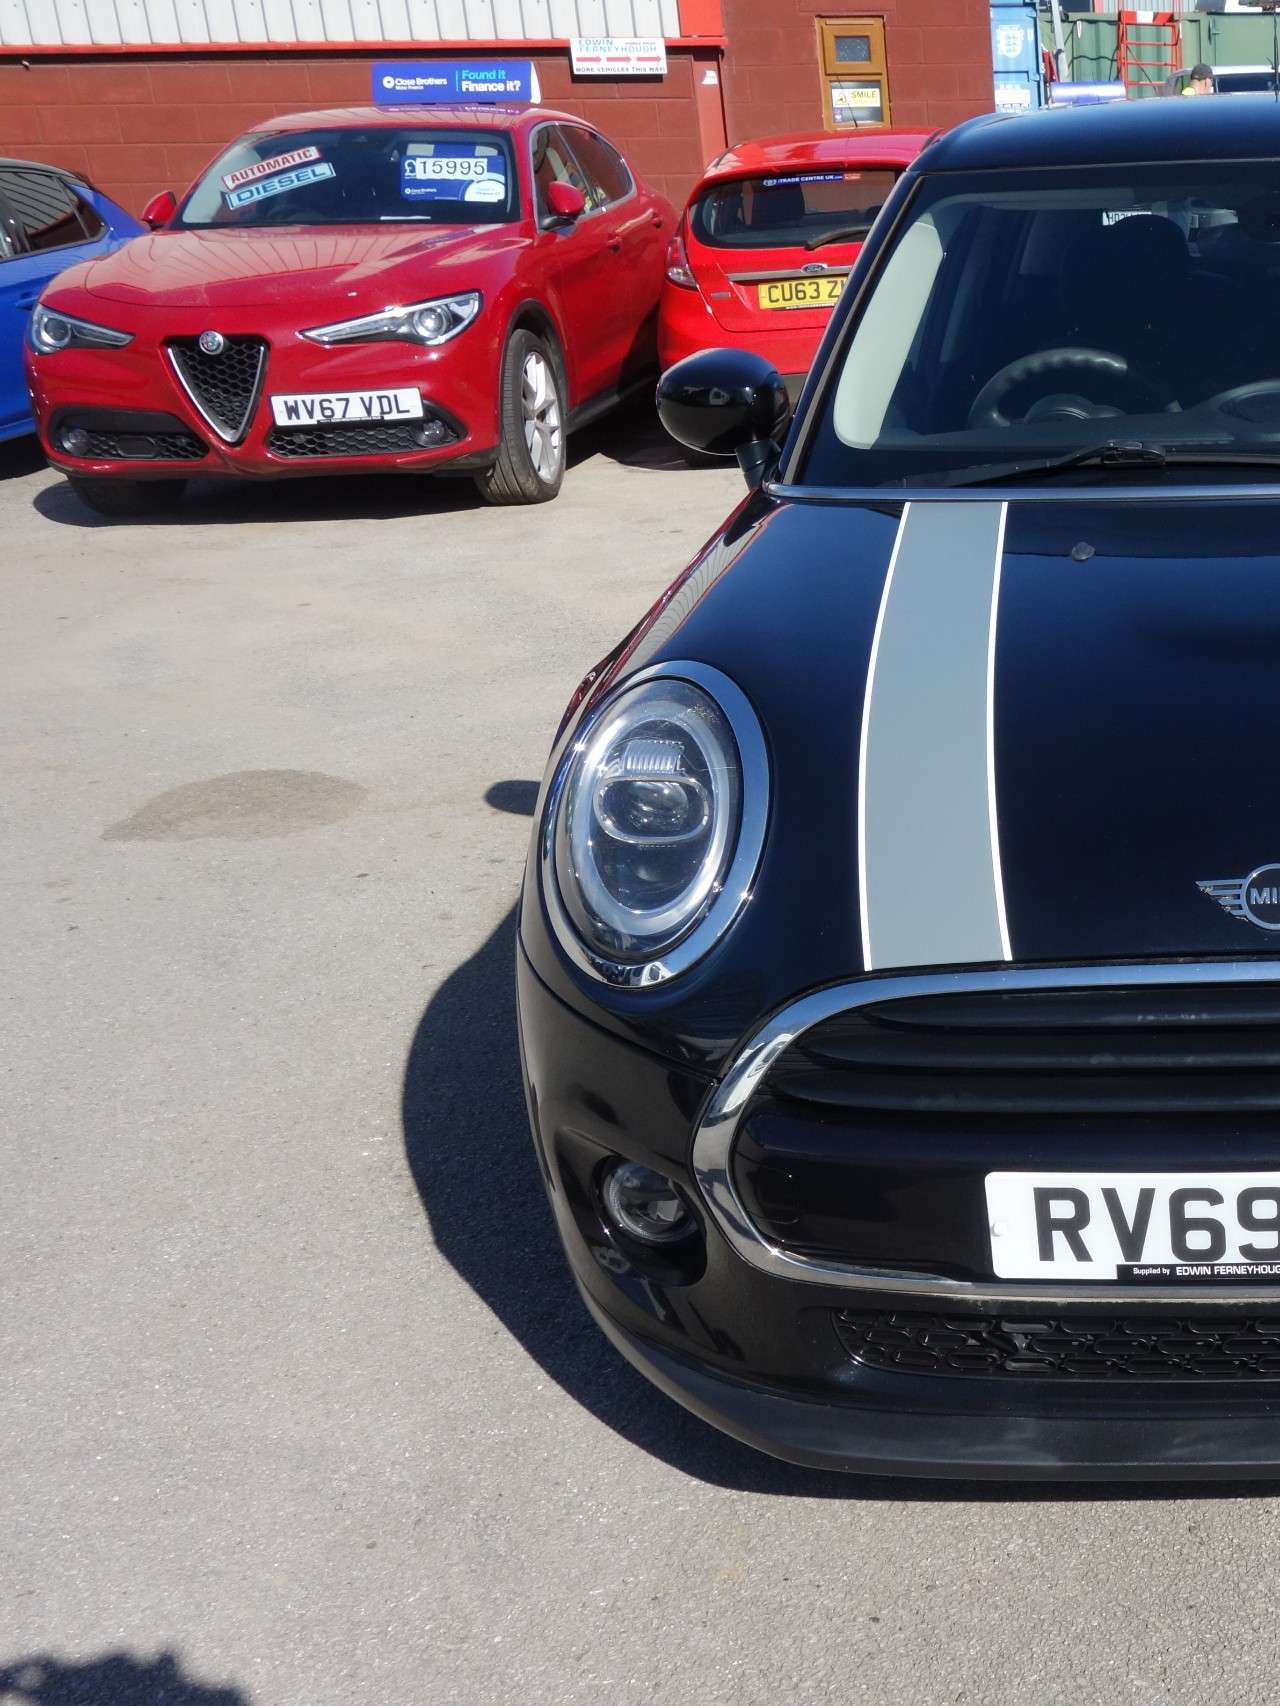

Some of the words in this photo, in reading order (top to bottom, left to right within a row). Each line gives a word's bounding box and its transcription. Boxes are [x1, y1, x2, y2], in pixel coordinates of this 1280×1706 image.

[462, 69, 497, 80] Found
[497, 69, 506, 80] it
[395, 77, 416, 86] Close
[416, 77, 448, 86] Brothers
[462, 80, 505, 92] Finance
[506, 80, 521, 92] it?
[851, 90, 877, 98] SMILE
[230, 149, 313, 184] AUTOMATIC
[800, 174, 825, 182] CENTRE
[236, 167, 326, 202] DIESEL
[768, 281, 821, 303] CU63
[827, 279, 846, 298] Z
[284, 398, 350, 420] WV67
[359, 394, 412, 417] VDL
[1132, 1267, 1161, 1276] Supplied
[1162, 1267, 1171, 1276] by
[1175, 1265, 1212, 1276] EDWIN
